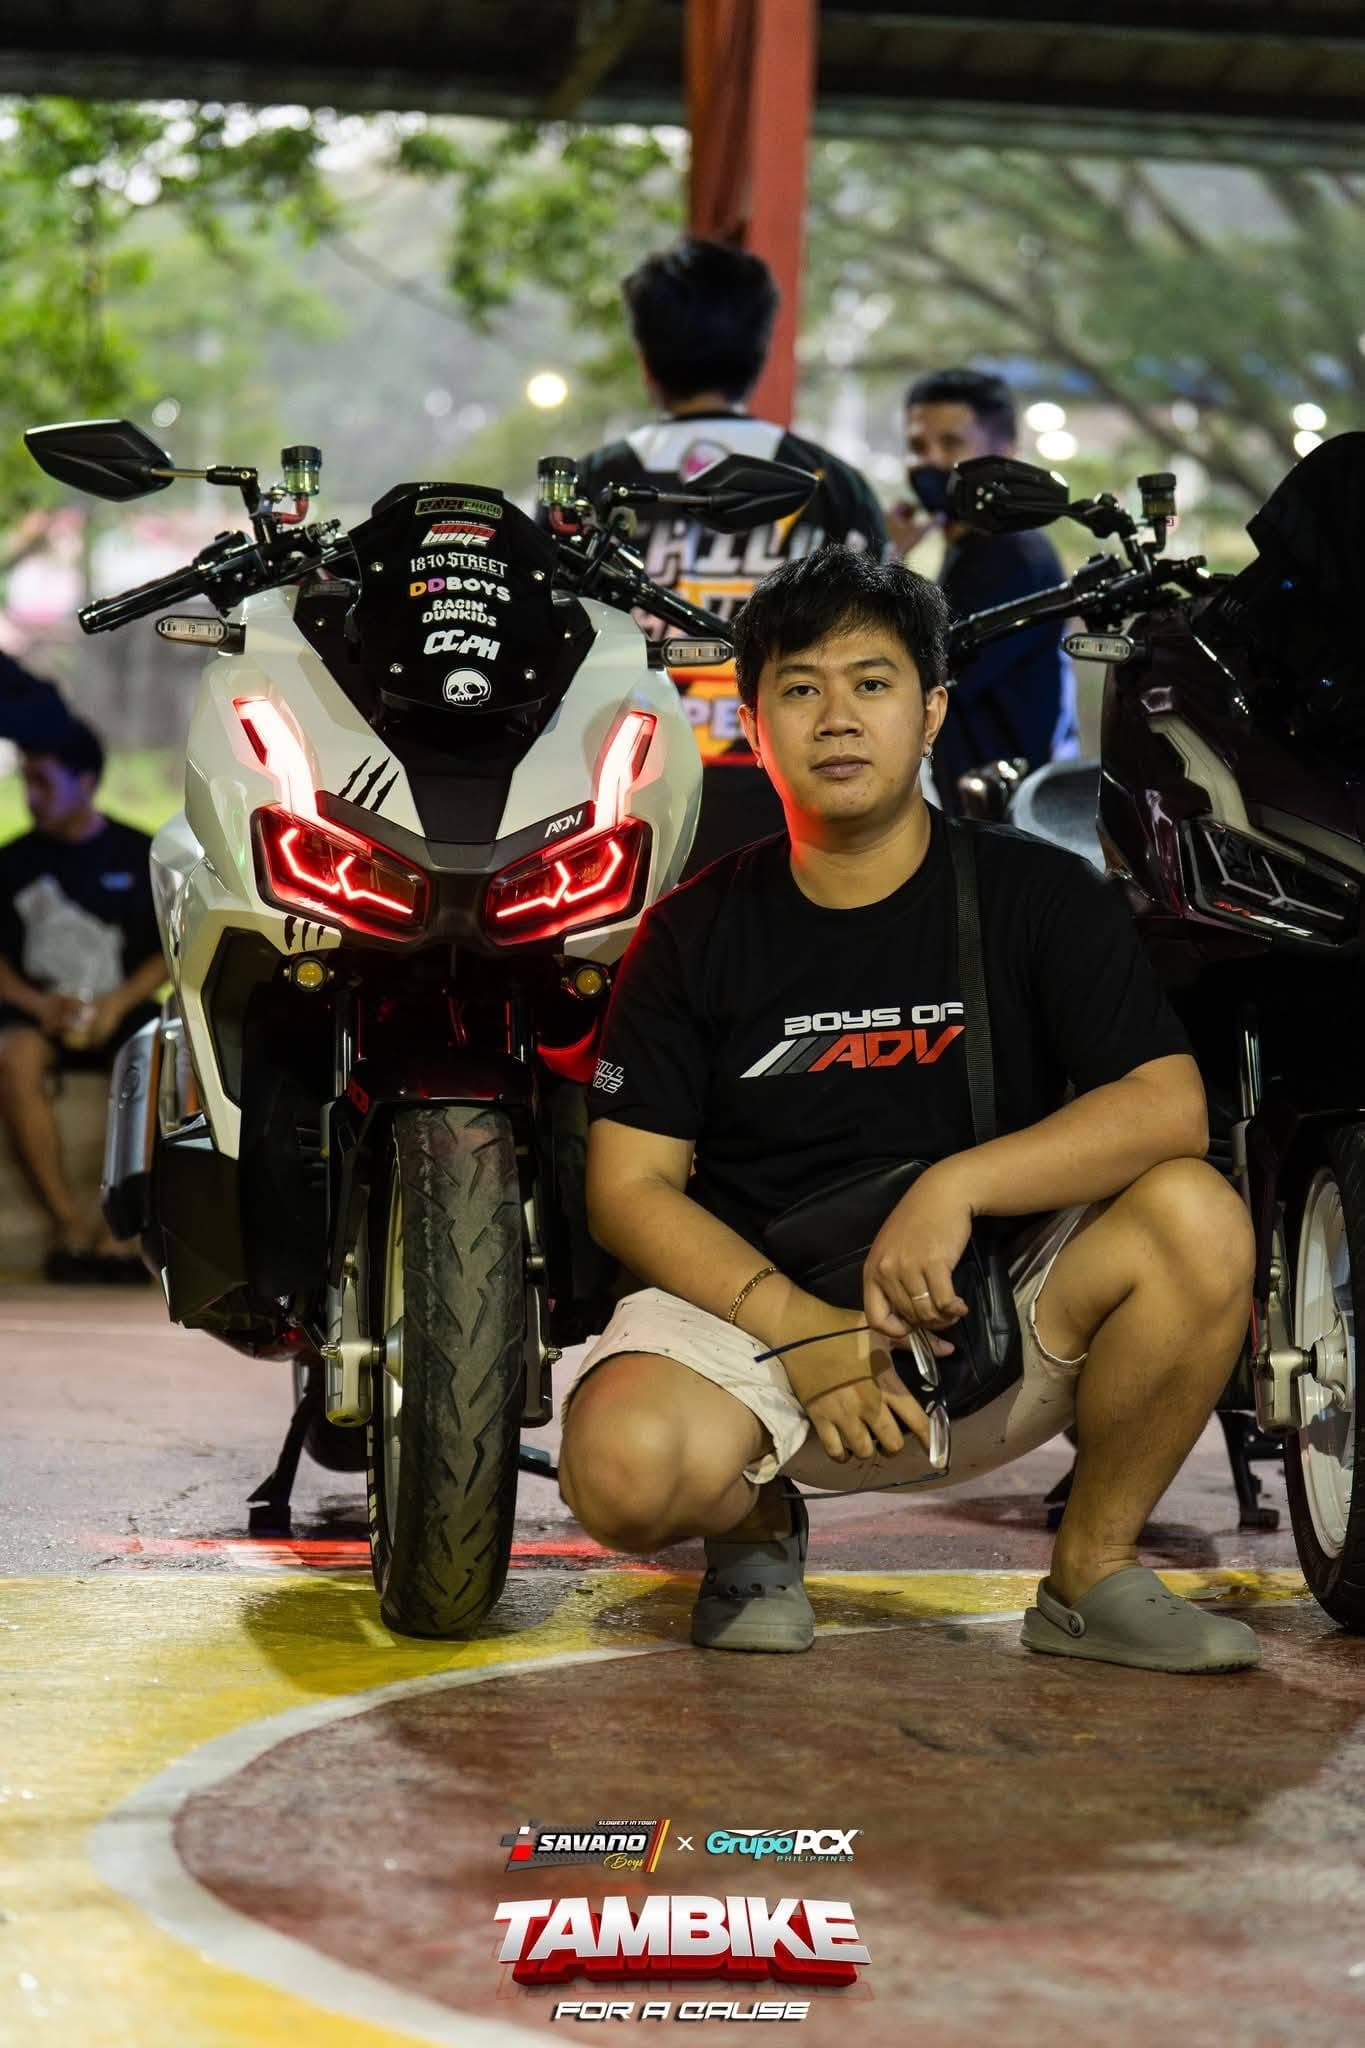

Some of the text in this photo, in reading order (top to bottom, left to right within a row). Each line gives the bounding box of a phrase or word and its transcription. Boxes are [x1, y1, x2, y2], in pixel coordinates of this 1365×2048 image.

[447, 552, 508, 578] STREET
[422, 609, 497, 627] DUNKIDS
[544, 810, 583, 839] ADV
[784, 1002, 964, 1036] BOYS OF
[807, 1025, 966, 1073] ADV
[596, 1058, 625, 1081] ILL
